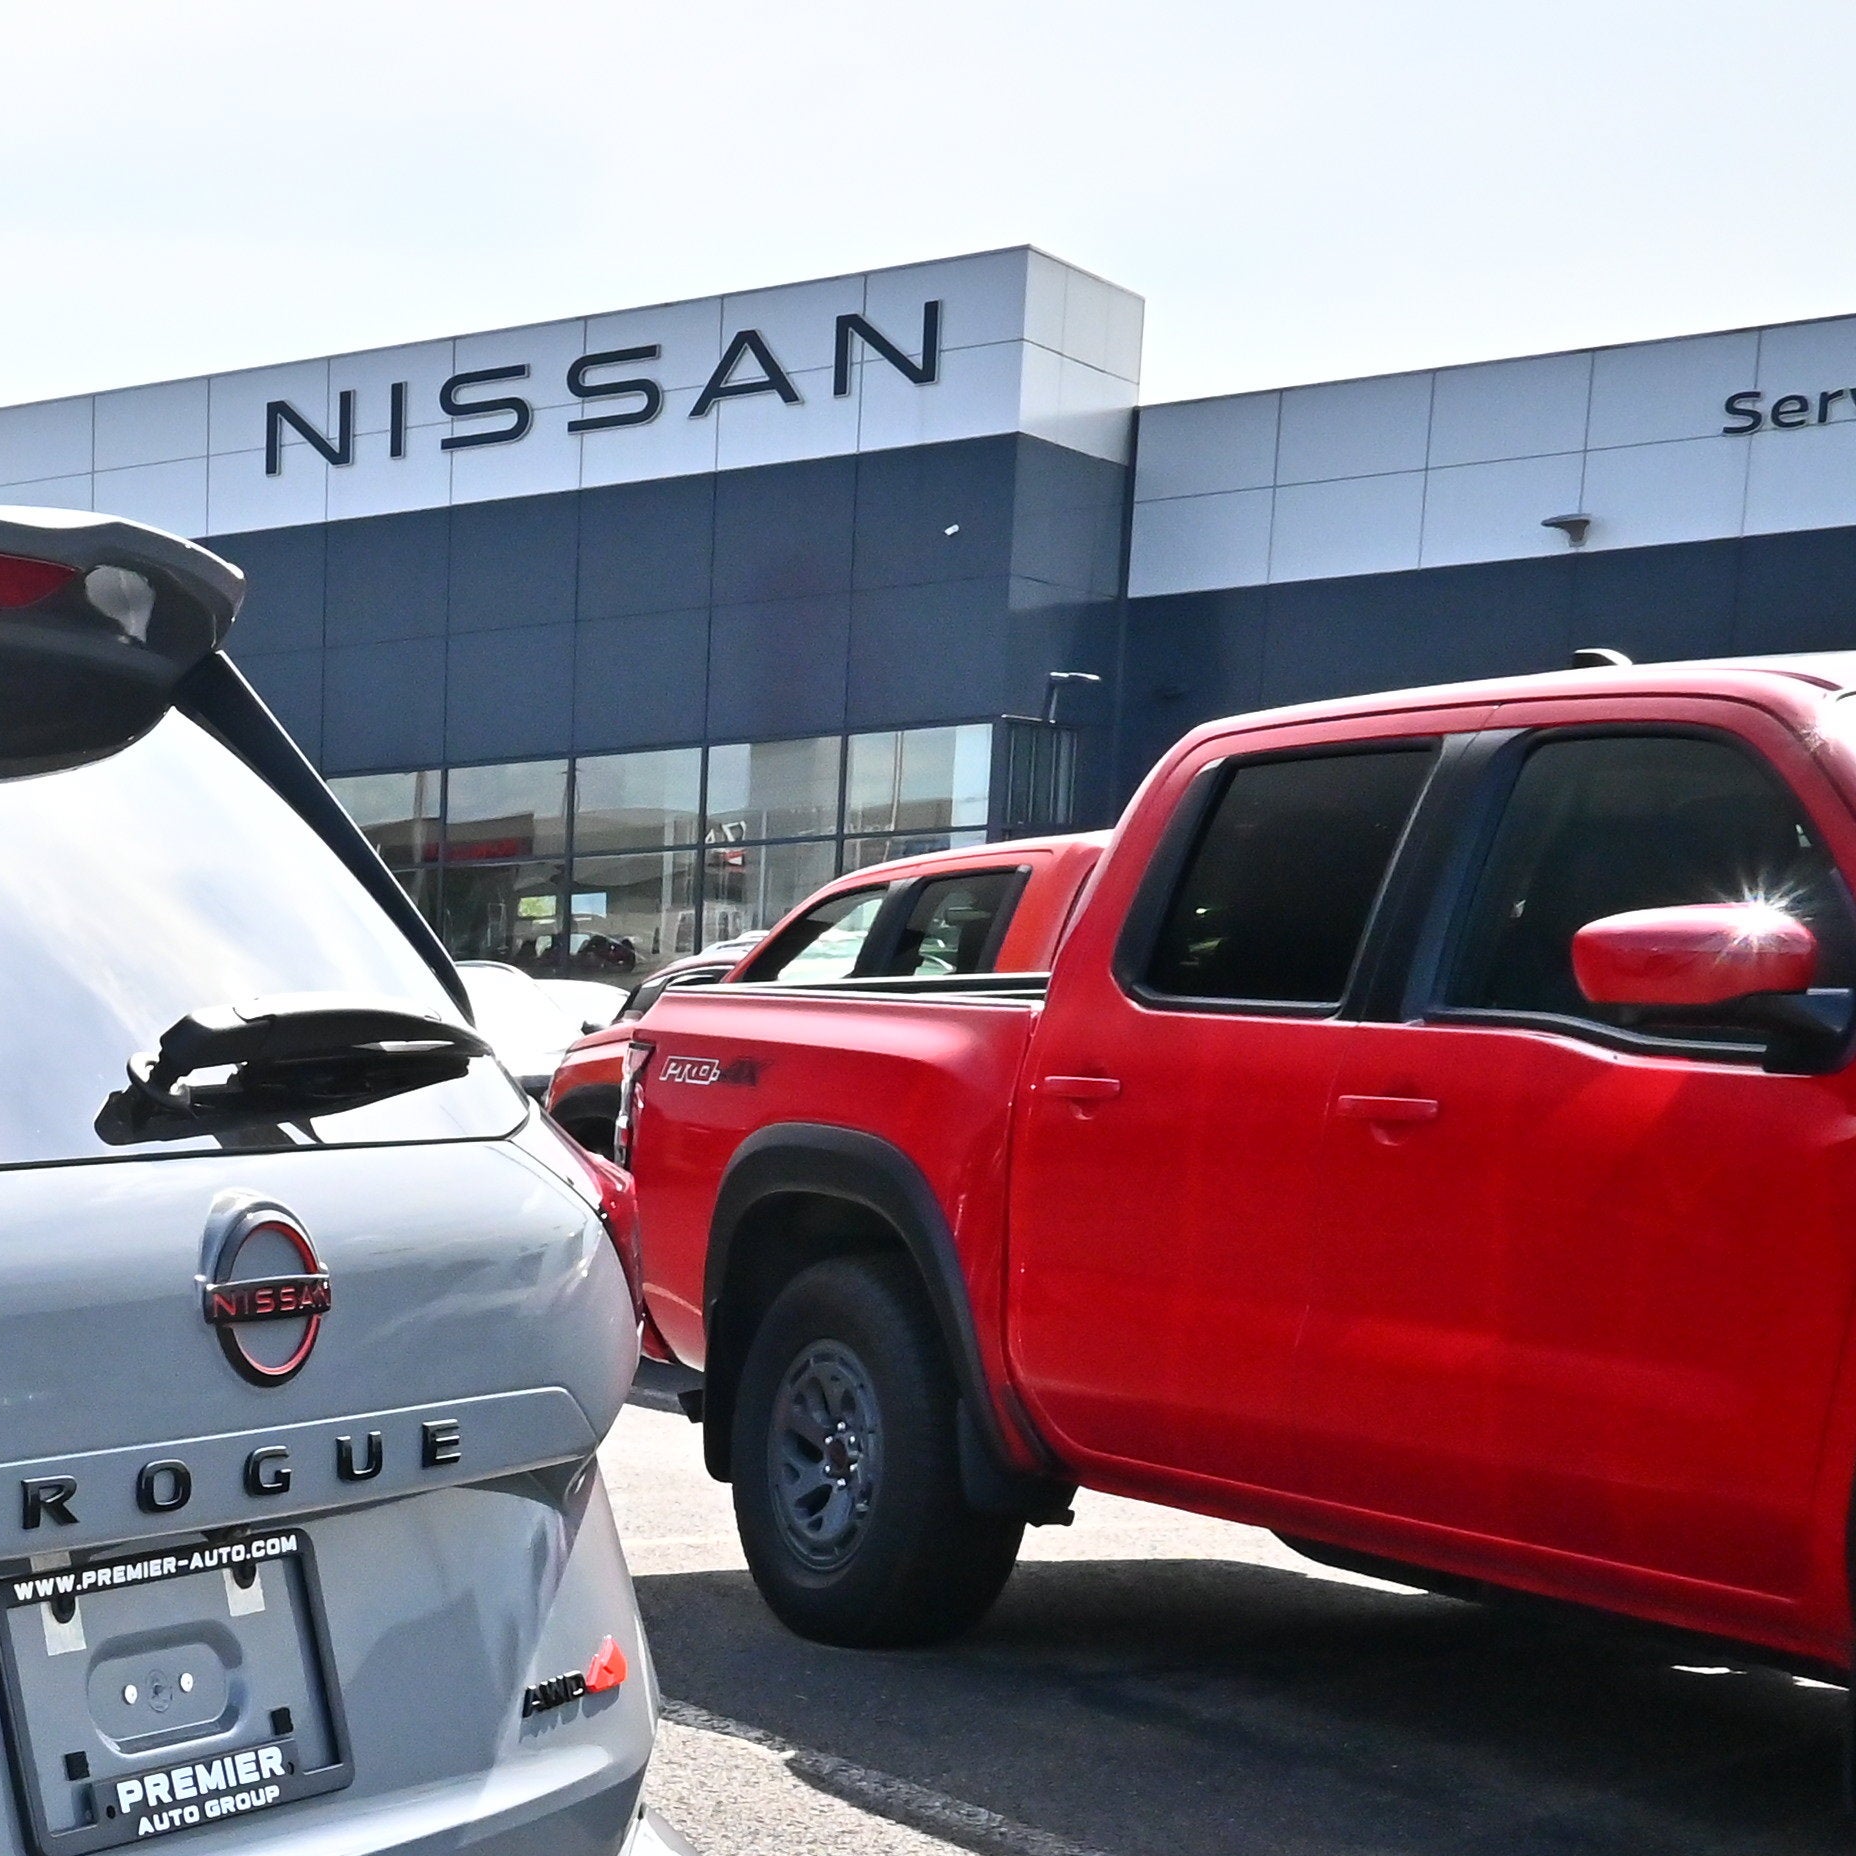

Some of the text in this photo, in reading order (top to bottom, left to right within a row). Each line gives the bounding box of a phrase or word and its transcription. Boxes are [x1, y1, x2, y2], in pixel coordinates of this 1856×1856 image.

[265, 299, 941, 476] NISSAN
[1722, 388, 1856, 434] Ser
[212, 1281, 330, 1318] NISSAN
[21, 1418, 461, 1529] ROGUE
[13, 1534, 298, 1601] WWW.PREMIER-AUTO.COM
[522, 1669, 586, 1718] AWD
[116, 1746, 285, 1814] PREMIER
[138, 1784, 280, 1836] AUTO GROUP
